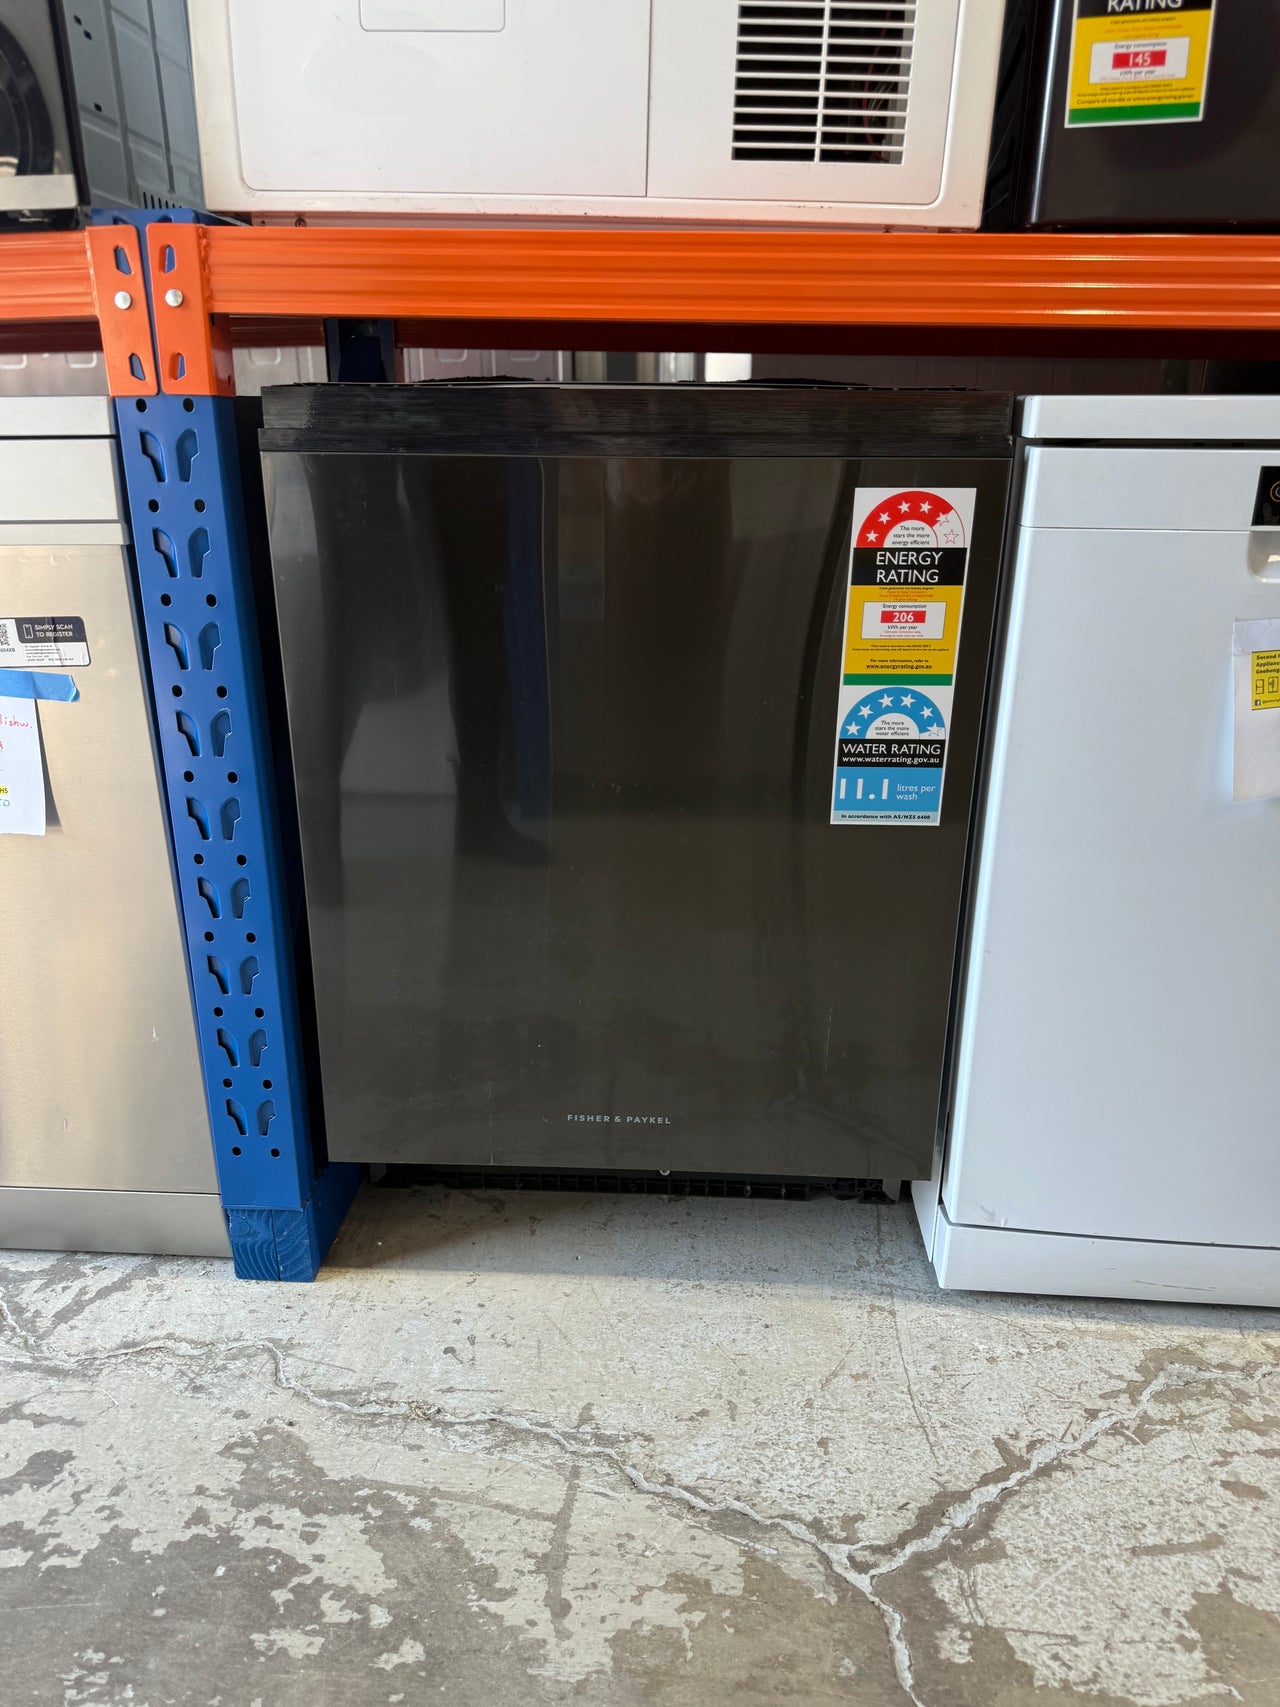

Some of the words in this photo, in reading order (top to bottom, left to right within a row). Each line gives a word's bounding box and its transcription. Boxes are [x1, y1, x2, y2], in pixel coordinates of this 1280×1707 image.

[1129, 53, 1151, 67] 145
[876, 551, 943, 565] ENERGY
[876, 569, 939, 583] RATING
[892, 612, 914, 623] 206
[842, 743, 887, 754] WATER
[891, 744, 941, 755] RATING
[842, 756, 940, 764] www.waterrating.gov.au
[839, 778, 889, 800] 11.1
[896, 784, 918, 792] litres
[920, 785, 936, 793] per
[896, 792, 918, 800] wash
[567, 1114, 611, 1122] FISHER
[614, 1115, 622, 1123] &
[626, 1116, 672, 1124] PAYKEL
